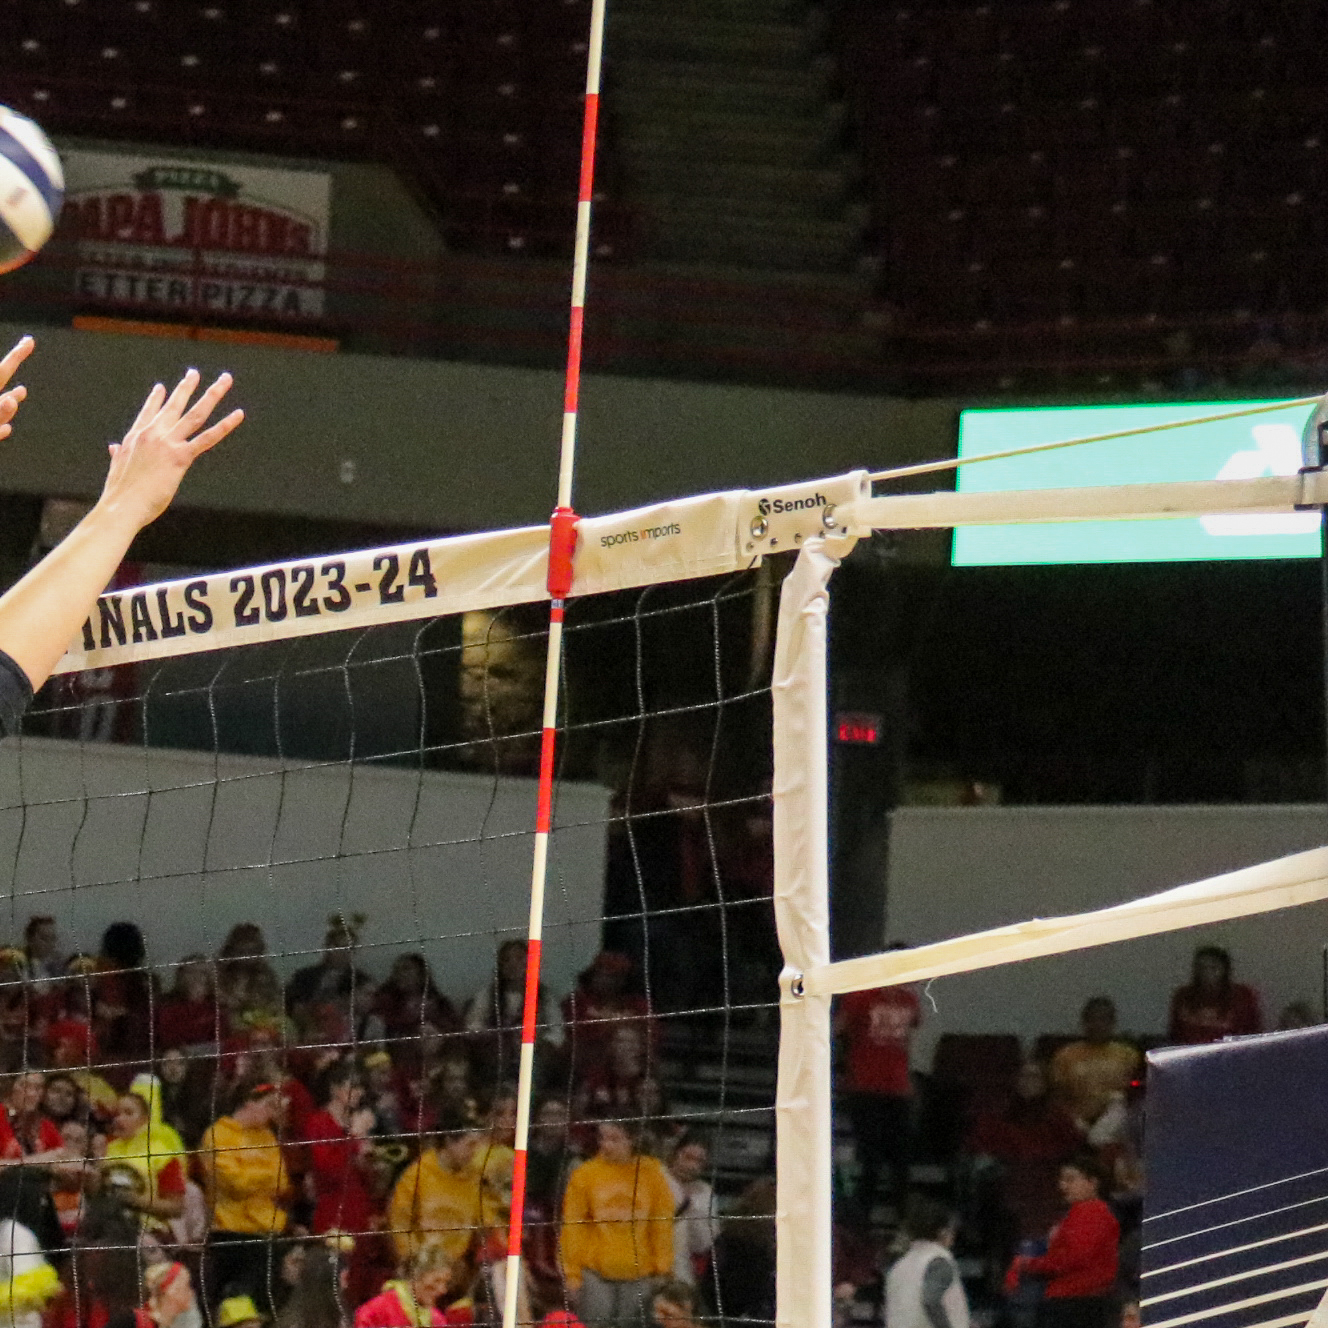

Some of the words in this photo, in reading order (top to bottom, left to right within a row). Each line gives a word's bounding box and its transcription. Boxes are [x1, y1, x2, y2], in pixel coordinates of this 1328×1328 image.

[772, 492, 827, 515] Senoh
[600, 531, 639, 548] sports
[640, 521, 682, 541] imports
[80, 579, 215, 650] INALS
[230, 547, 439, 630] 2023-24
